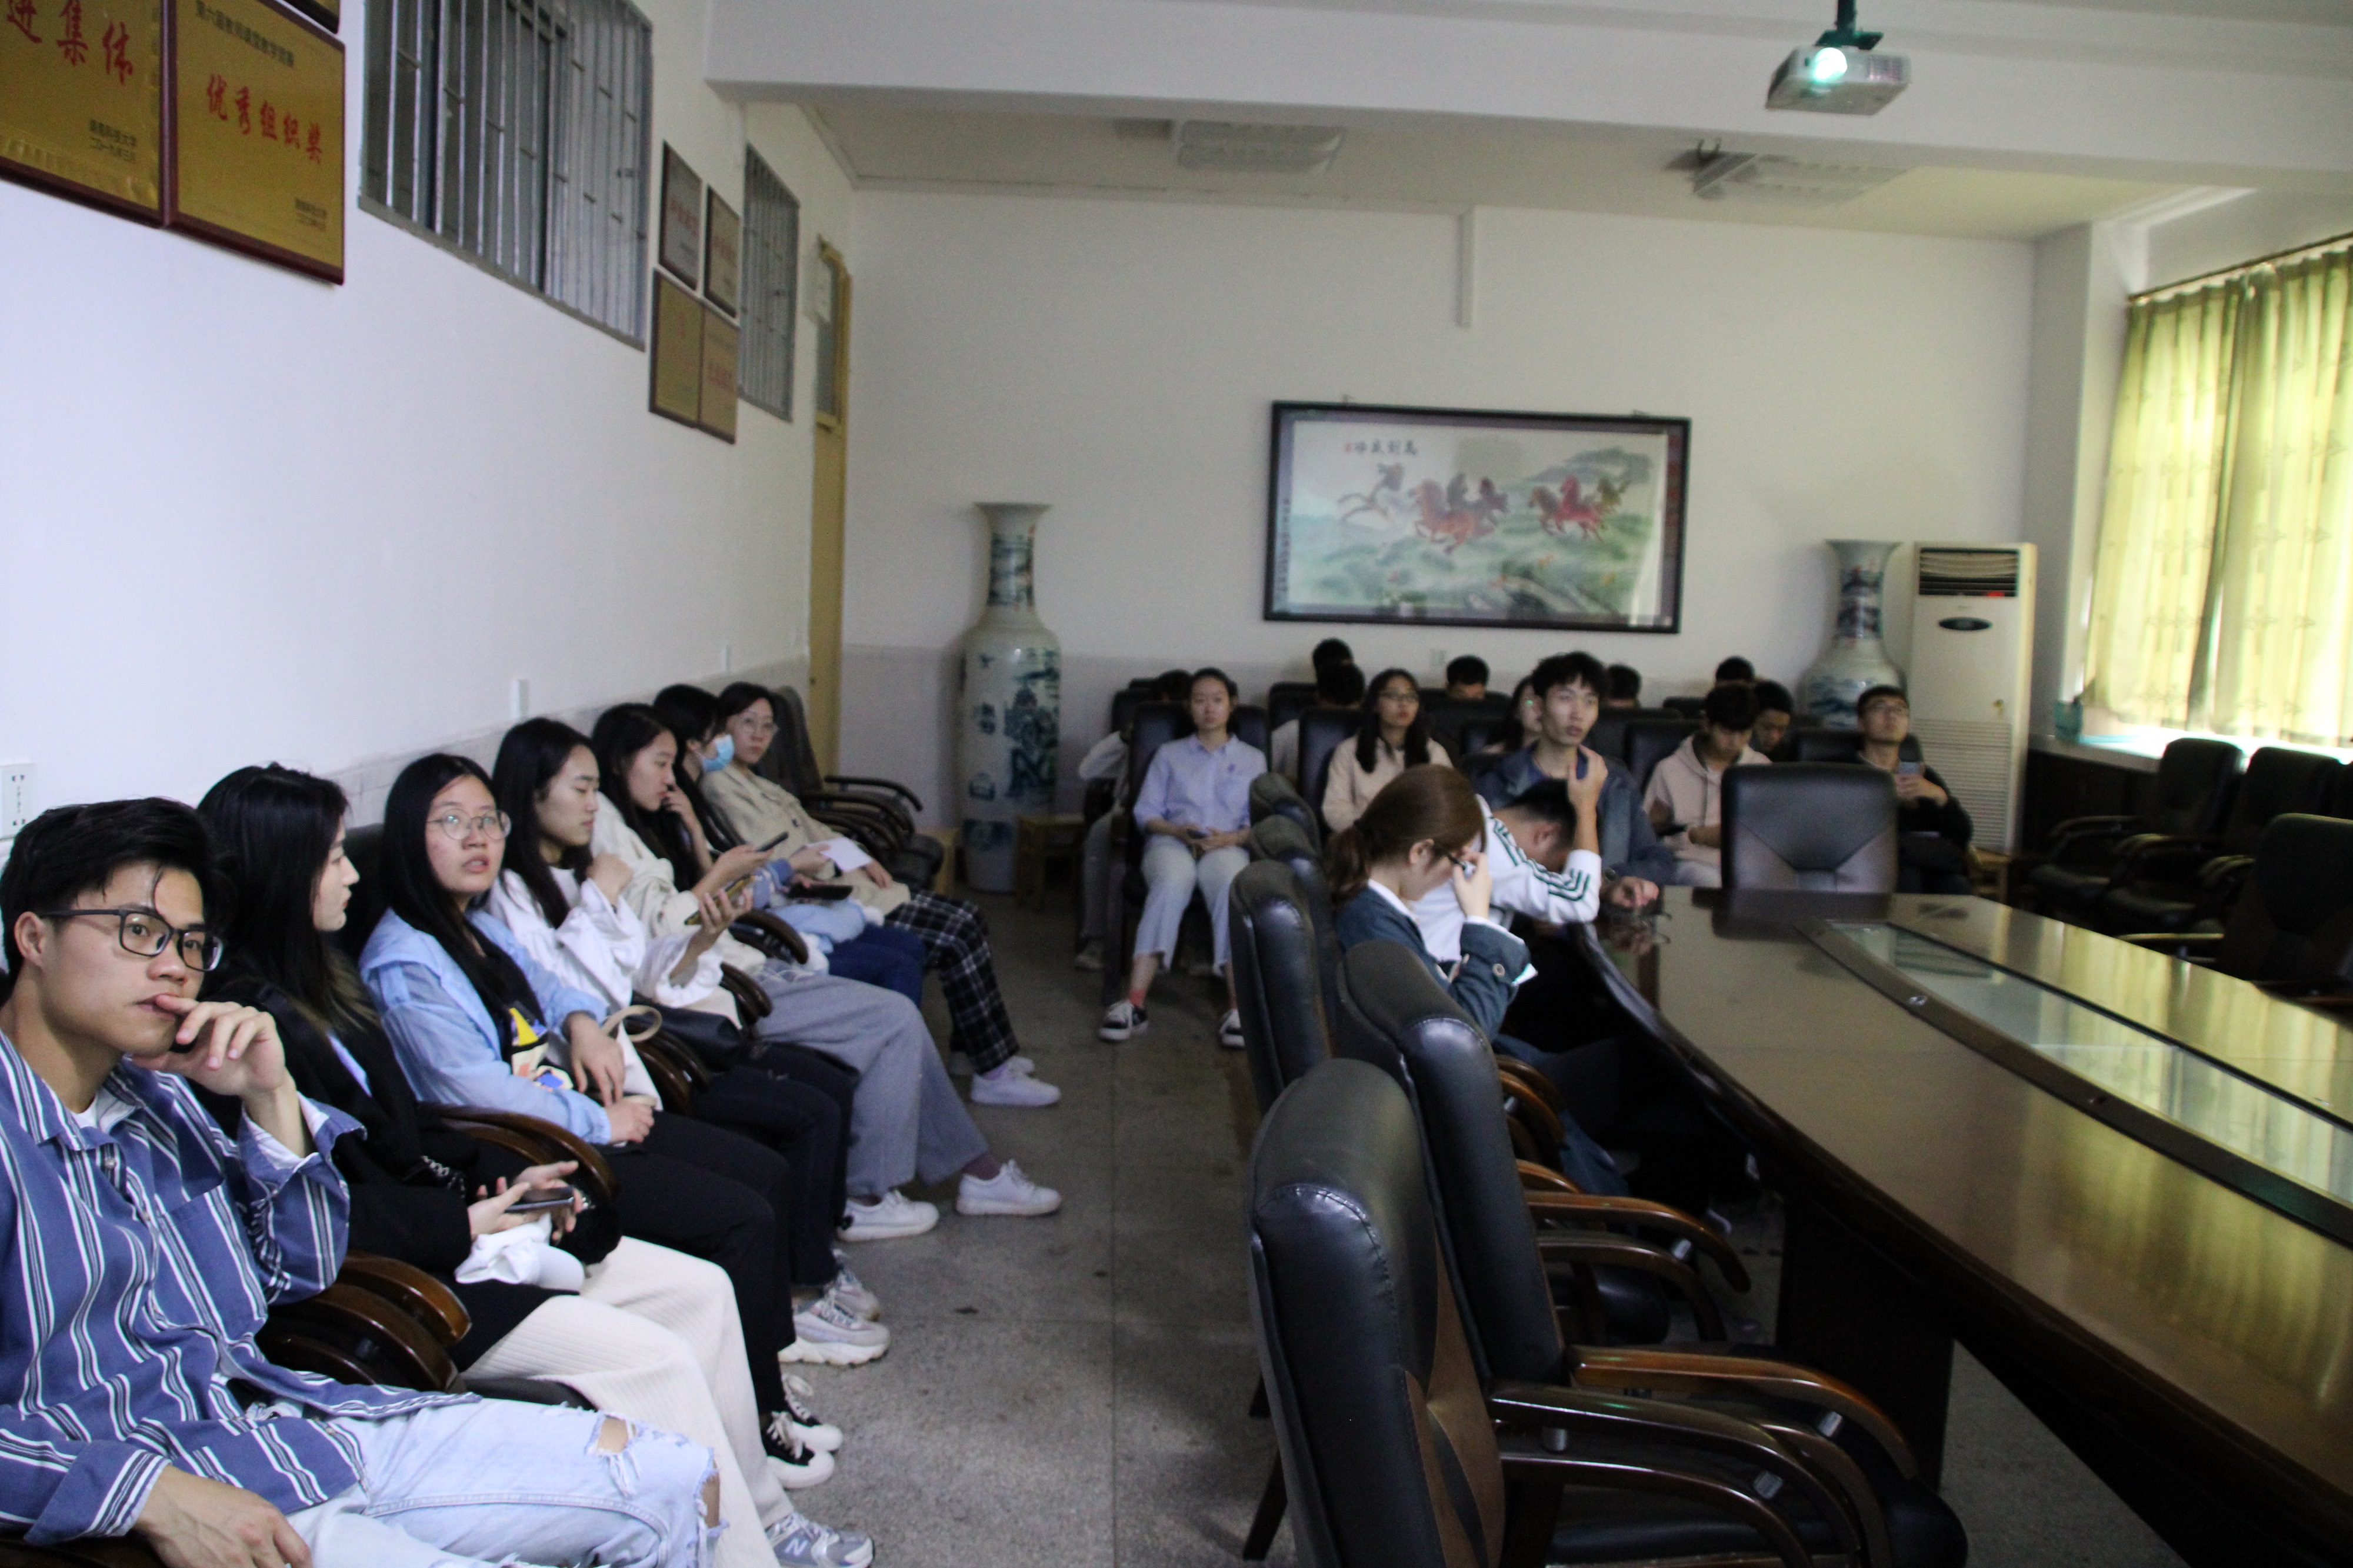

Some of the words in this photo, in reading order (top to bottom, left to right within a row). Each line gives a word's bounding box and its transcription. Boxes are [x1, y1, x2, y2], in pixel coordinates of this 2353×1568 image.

[206, 74, 323, 165] 优秀组织奖
[784, 1538, 809, 1557] N
